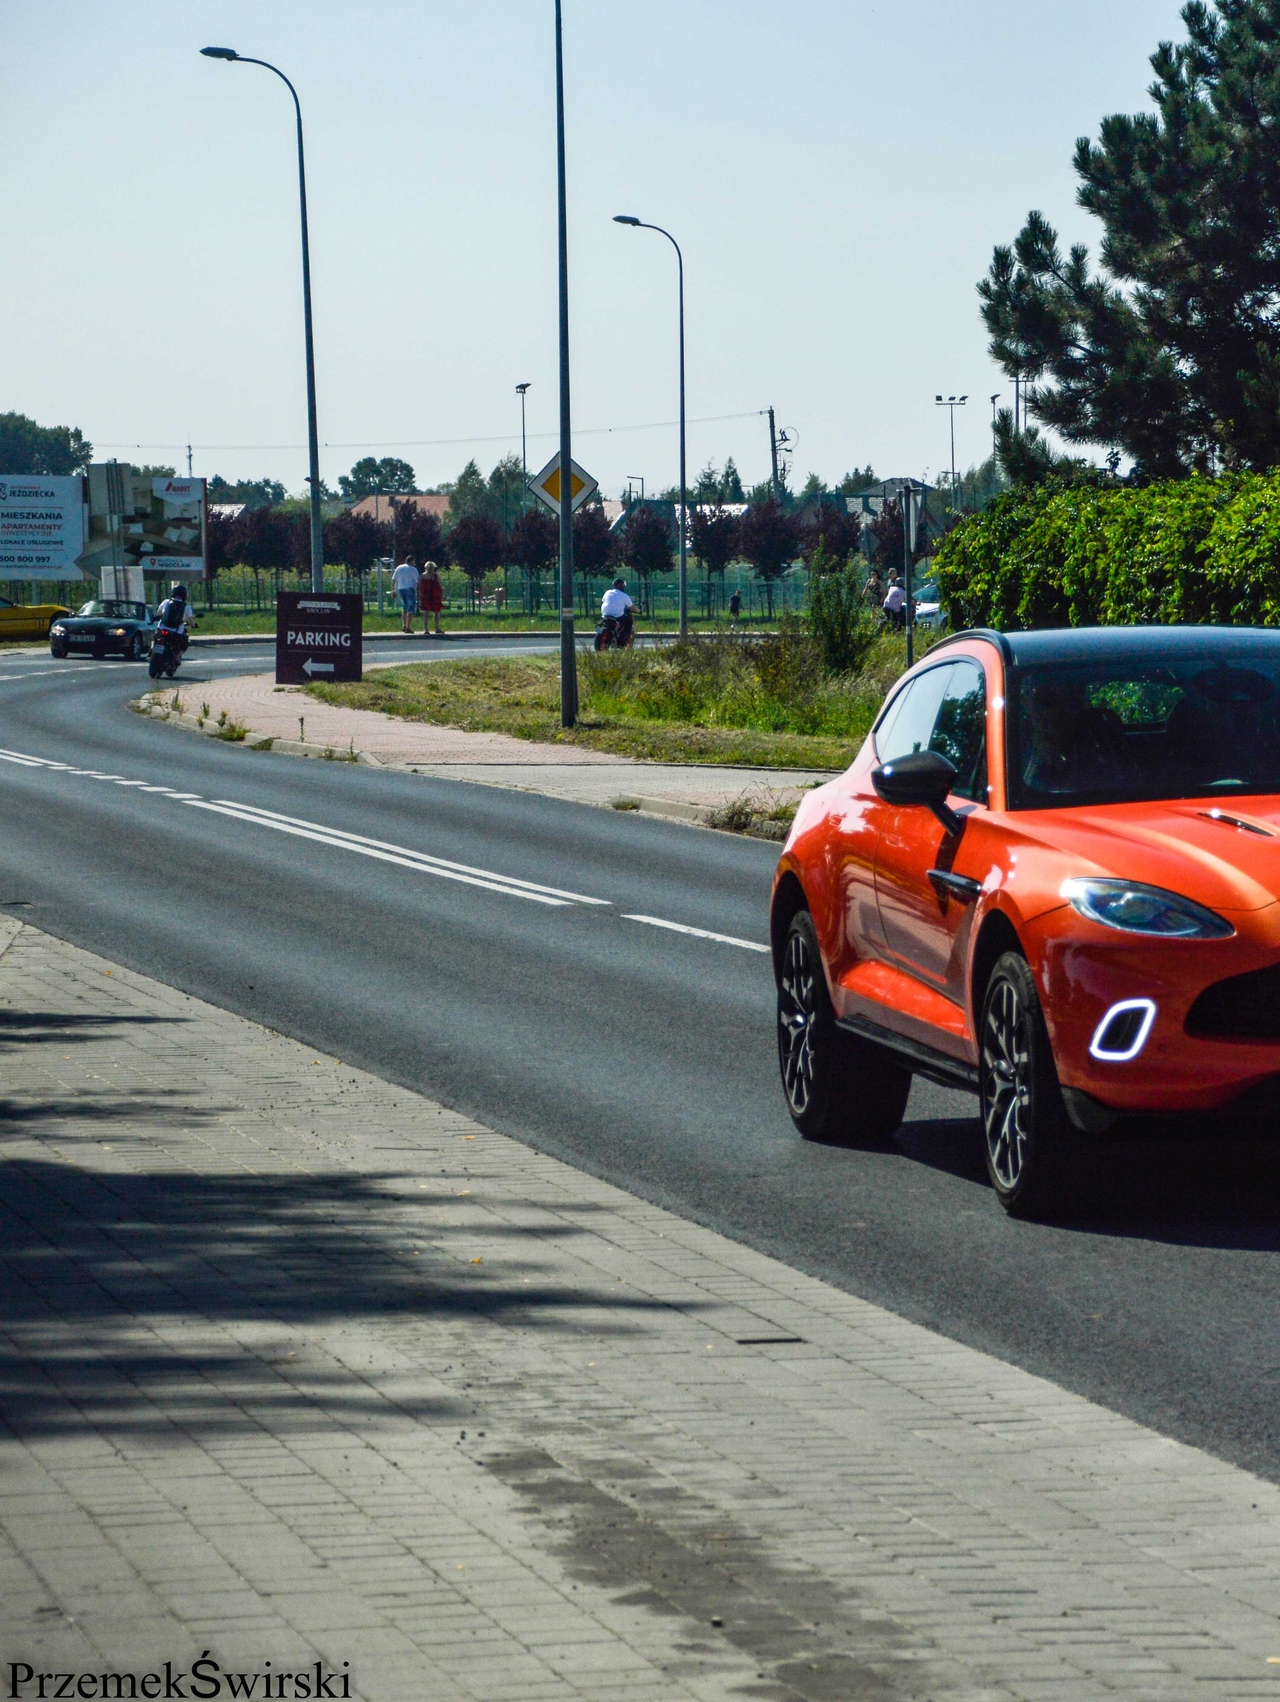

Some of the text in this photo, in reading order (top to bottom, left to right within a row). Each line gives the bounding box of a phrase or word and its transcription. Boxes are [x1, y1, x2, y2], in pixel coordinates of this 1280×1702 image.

[1, 512, 63, 520] MIESZKANIA
[1, 523, 63, 531] APARTAMENTY
[286, 631, 351, 647] PARKING
